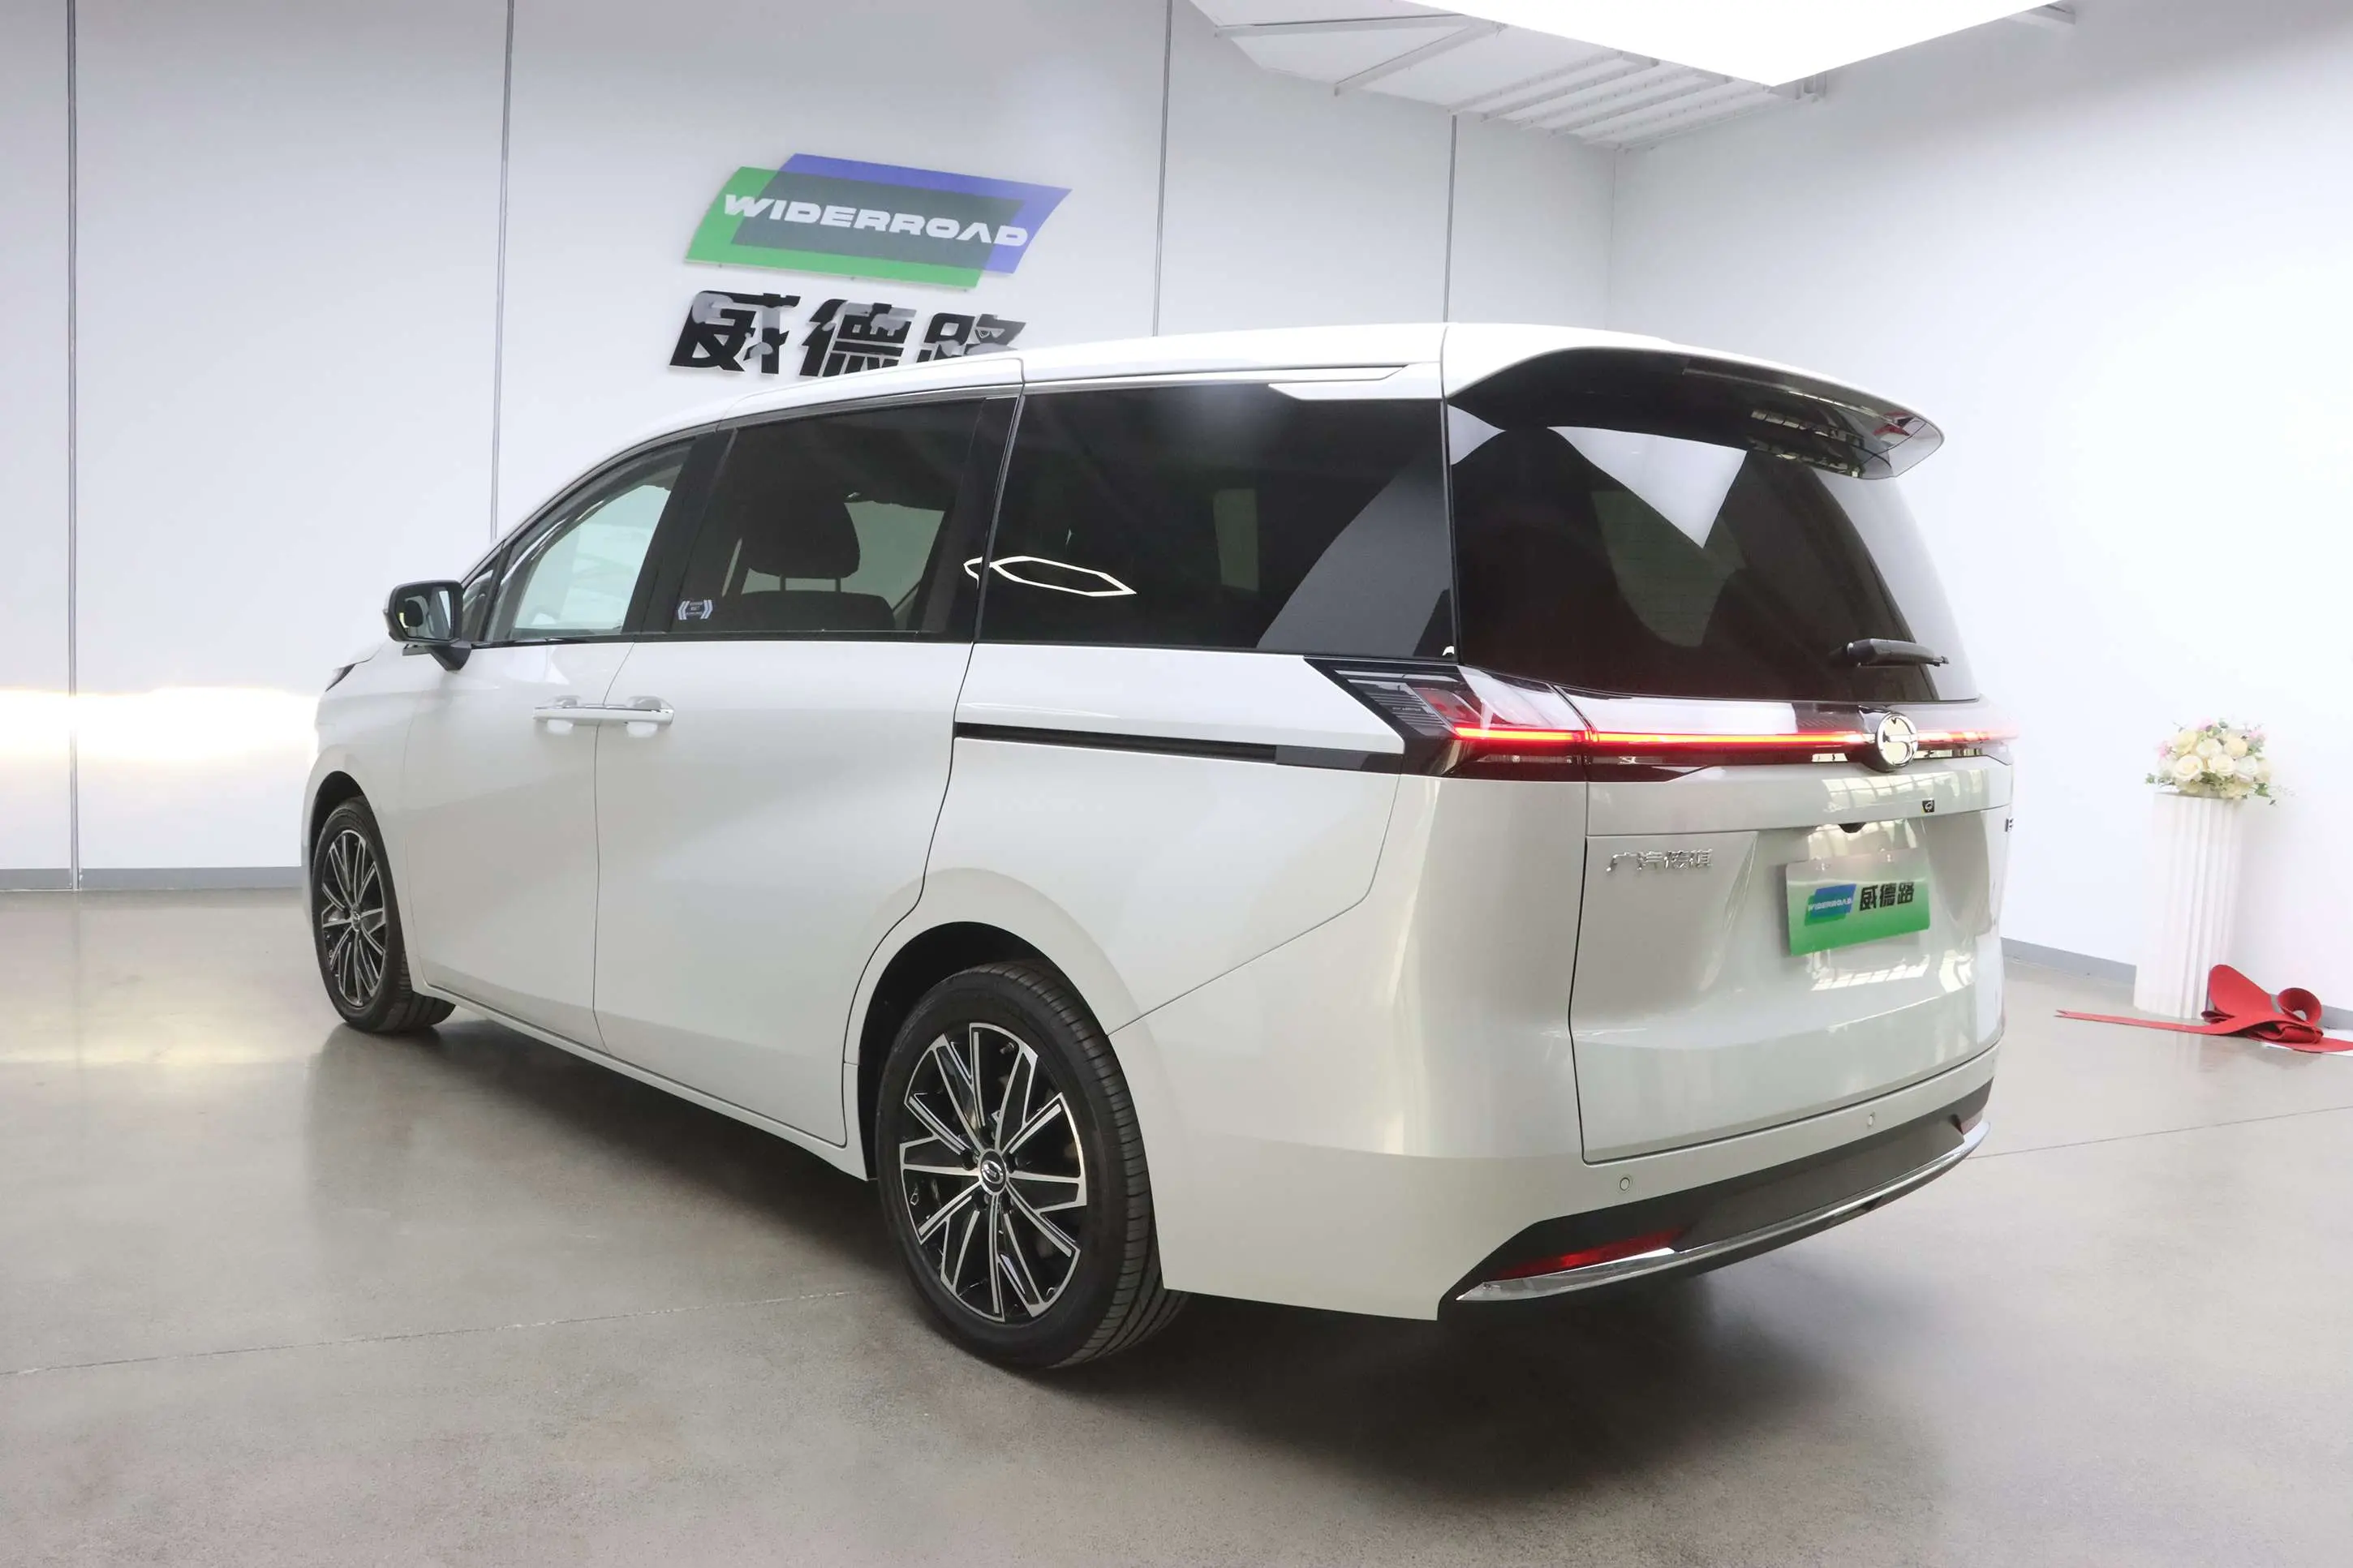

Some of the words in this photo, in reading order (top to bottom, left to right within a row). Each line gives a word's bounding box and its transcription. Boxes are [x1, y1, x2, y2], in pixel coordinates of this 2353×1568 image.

[724, 194, 1028, 247] WIDERROAD
[1859, 882, 1915, 912] 威德路
